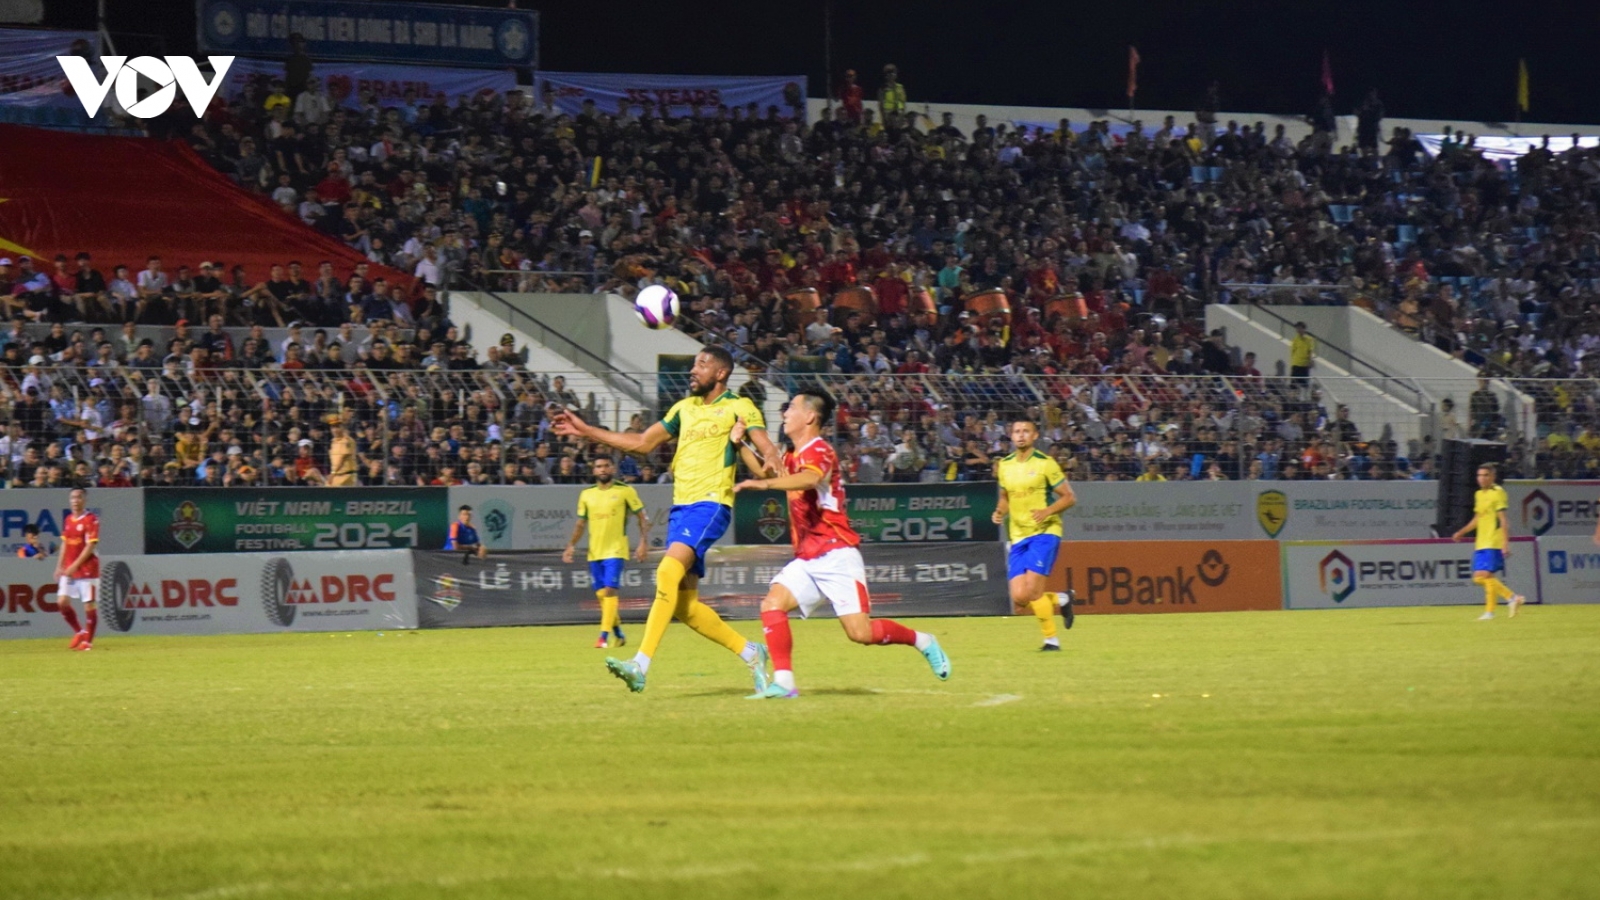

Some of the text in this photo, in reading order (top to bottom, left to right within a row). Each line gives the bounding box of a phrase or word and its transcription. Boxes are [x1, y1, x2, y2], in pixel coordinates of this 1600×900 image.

[284, 501, 331, 516] NAM
[345, 500, 417, 515] BRAZIL
[854, 498, 896, 511] NAM
[908, 496, 971, 511] BRAZIL
[1294, 499, 1348, 510] BRAZILIAN
[1351, 499, 1403, 510] FOOTBALL
[1406, 499, 1438, 509] SCHO
[235, 524, 310, 534] FOOTBALL
[847, 518, 878, 528] BALL
[880, 517, 972, 541] 2024
[235, 538, 306, 549] FESTIVAL
[313, 522, 418, 548] 2024
[571, 569, 642, 588] BG
[754, 566, 785, 584] NA
[864, 565, 912, 583] AZIL
[914, 563, 988, 582] 2024
[1360, 559, 1505, 581] PROWTE
[160, 578, 239, 608] DRC
[320, 574, 396, 604] DRC
[1066, 567, 1197, 605] LPBank
[0, 583, 59, 614] RC
